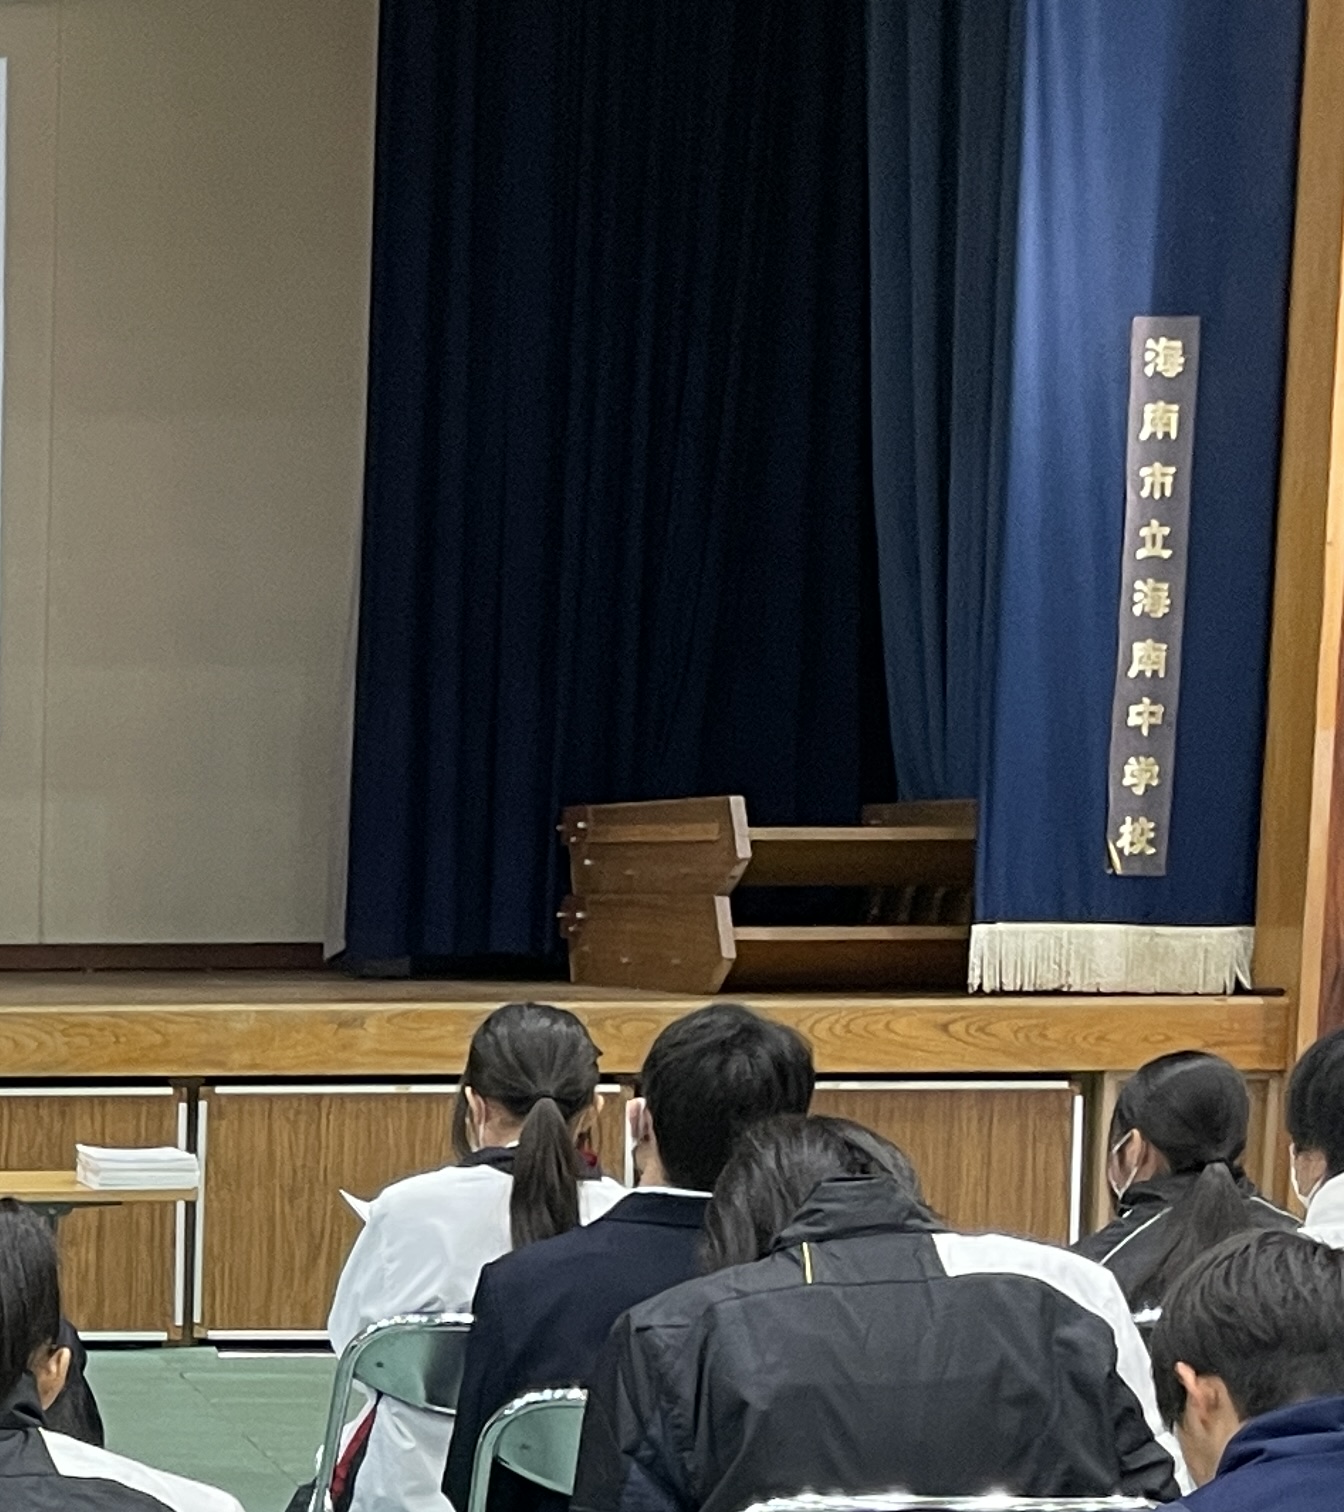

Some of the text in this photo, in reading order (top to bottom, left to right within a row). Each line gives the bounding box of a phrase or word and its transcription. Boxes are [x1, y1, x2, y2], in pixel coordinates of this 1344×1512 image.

[1115, 336, 1186, 858] 海南市立海南中学校
